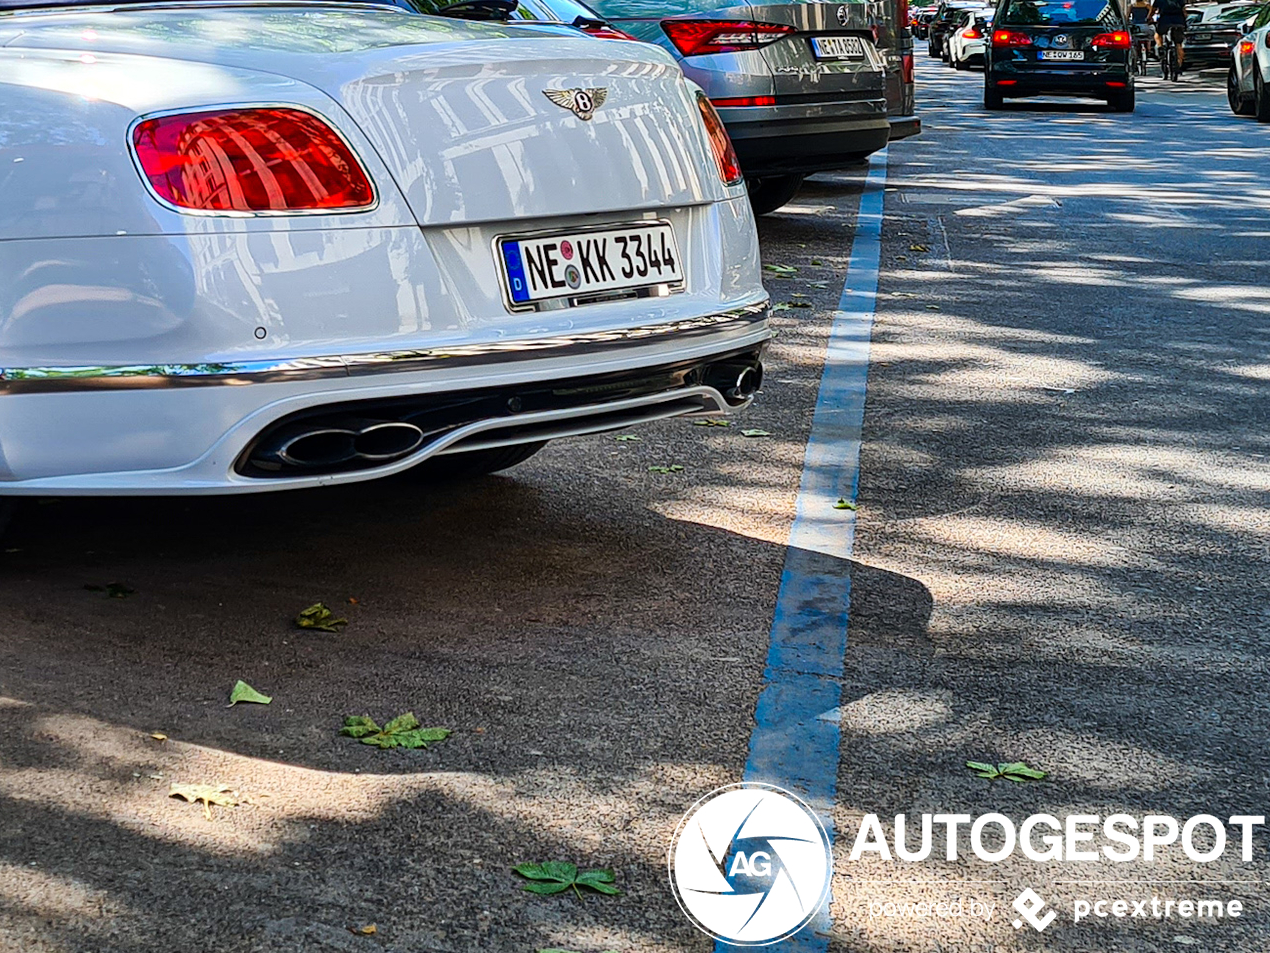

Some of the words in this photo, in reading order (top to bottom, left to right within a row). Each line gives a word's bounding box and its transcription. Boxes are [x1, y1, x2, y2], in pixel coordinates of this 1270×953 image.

[525, 243, 567, 292] NE
[577, 238, 616, 284] KK
[615, 232, 676, 279] 3344
